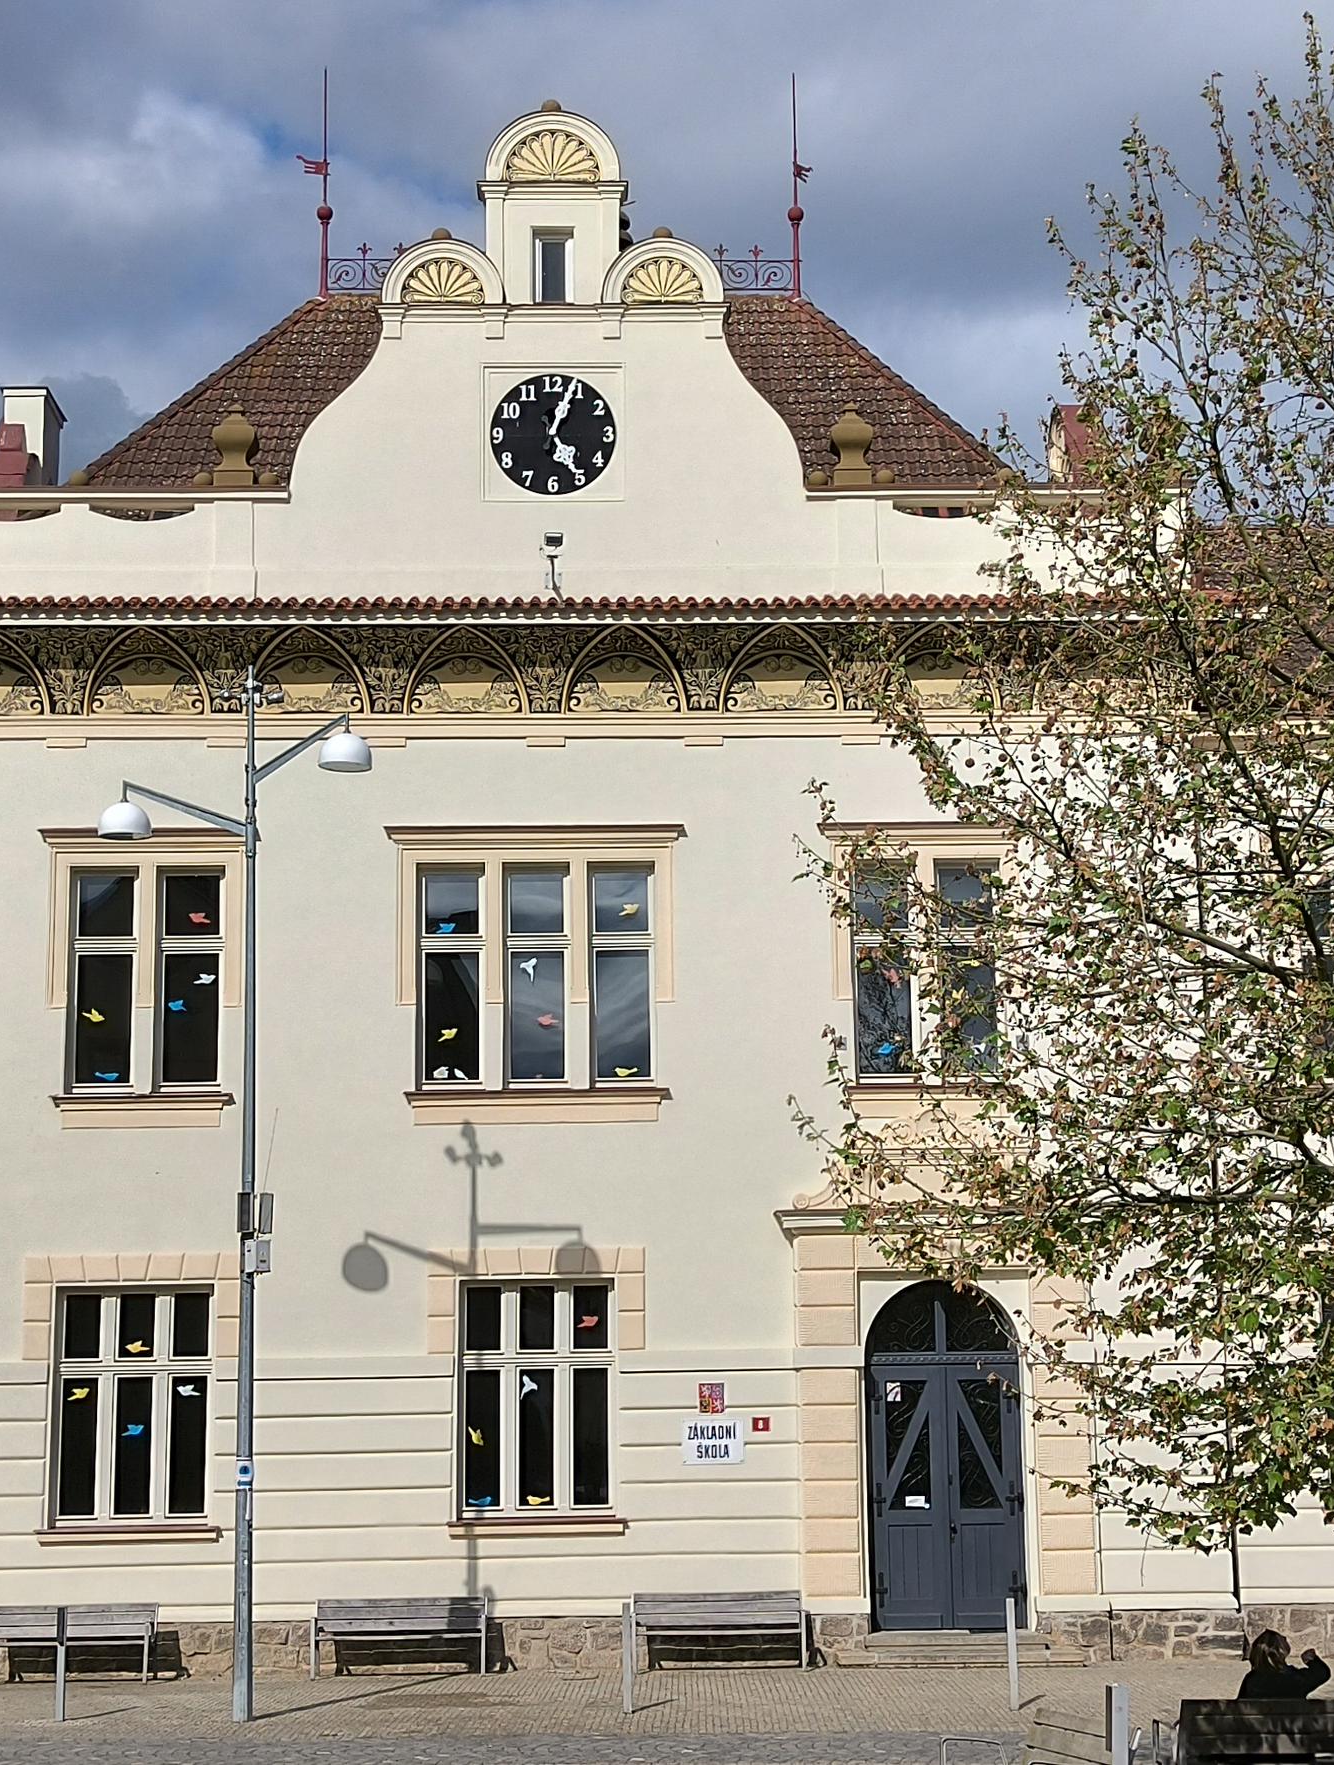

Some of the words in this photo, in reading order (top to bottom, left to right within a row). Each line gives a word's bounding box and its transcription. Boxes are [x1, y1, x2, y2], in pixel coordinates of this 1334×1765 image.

[542, 376, 563, 392] 12
[575, 382, 584, 399] 1
[519, 385, 537, 401] 11
[501, 402, 520, 419] 10
[592, 399, 605, 415] 2
[492, 427, 504, 444] 9
[602, 426, 614, 443] 3
[501, 452, 513, 468] 8
[592, 451, 604, 467] 4
[522, 470, 534, 487] 7
[547, 476, 559, 492] 6
[574, 469, 586, 486] 5
[687, 1422, 737, 1440] ZÁKLADNÍ
[696, 1442, 730, 1459] ŠKOLA
